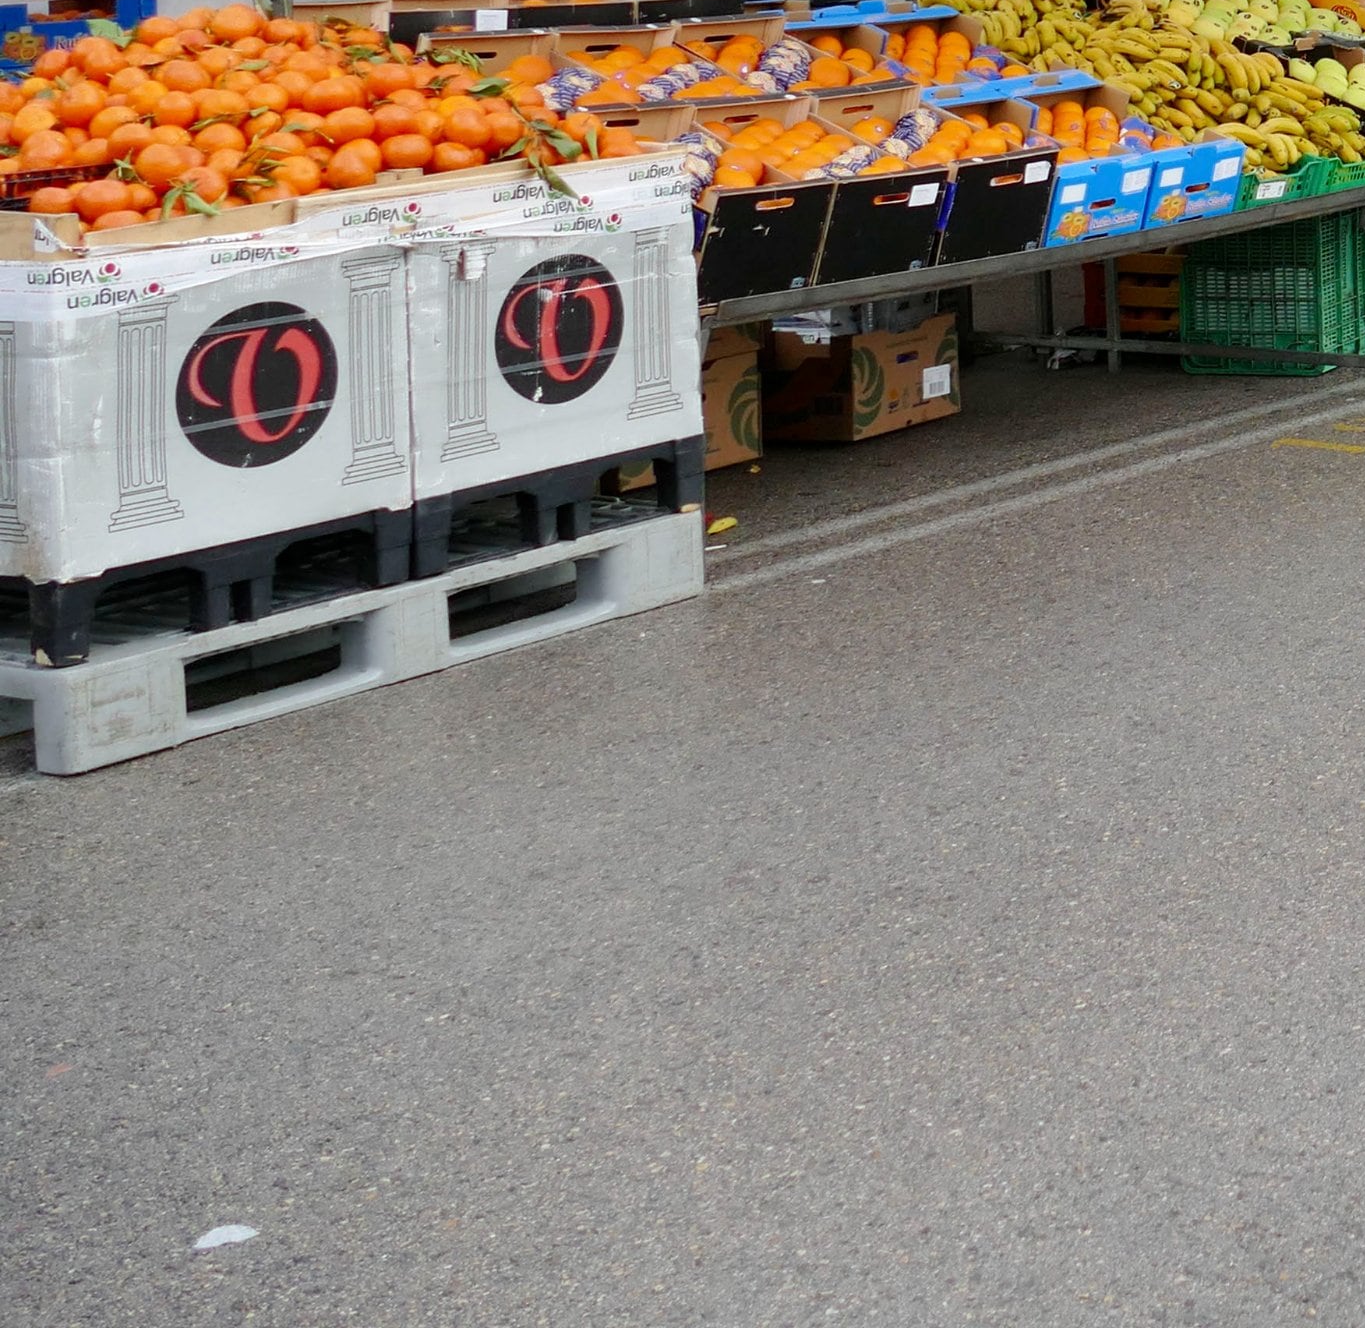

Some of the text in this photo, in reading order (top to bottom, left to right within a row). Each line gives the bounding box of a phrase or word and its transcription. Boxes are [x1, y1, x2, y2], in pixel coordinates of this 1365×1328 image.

[493, 184, 545, 203] Valgren
[342, 207, 400, 227] Valgren
[523, 200, 574, 218] Valgren
[554, 217, 603, 233] Valgren
[211, 247, 275, 265] Valgren
[27, 268, 94, 286] Valgren
[67, 288, 138, 309] Valgren
